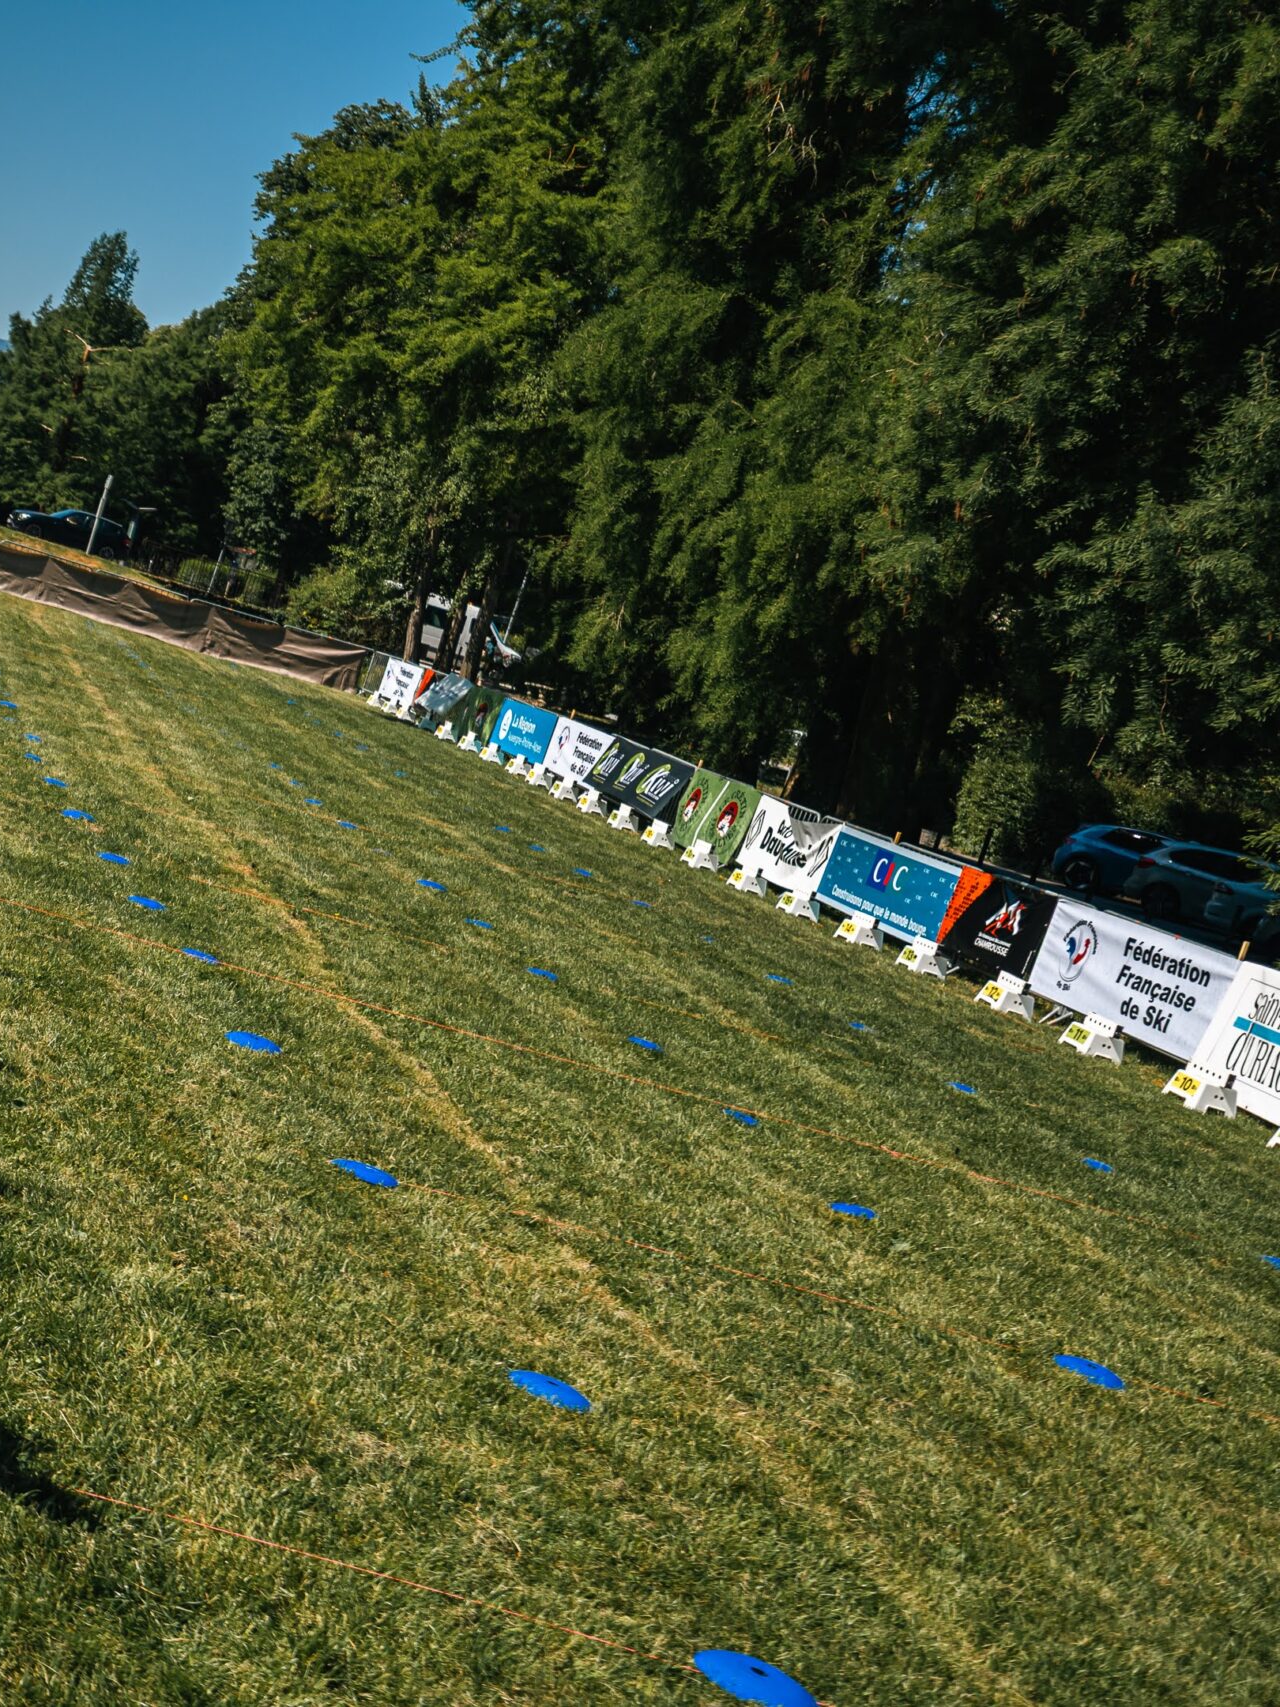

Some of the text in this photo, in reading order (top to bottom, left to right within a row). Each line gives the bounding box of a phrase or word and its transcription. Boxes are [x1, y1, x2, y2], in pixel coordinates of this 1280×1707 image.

[873, 858, 908, 891] CIC
[861, 900, 875, 911] pour
[873, 905, 885, 917] que
[884, 907, 890, 920] le
[889, 912, 909, 928] monde
[974, 938, 1009, 957] CHAMROUSSE
[1123, 937, 1212, 988] Fédération
[1116, 965, 1196, 1013] Française
[1120, 997, 1173, 1034] de Ski
[1180, 1076, 1193, 1091] 10
